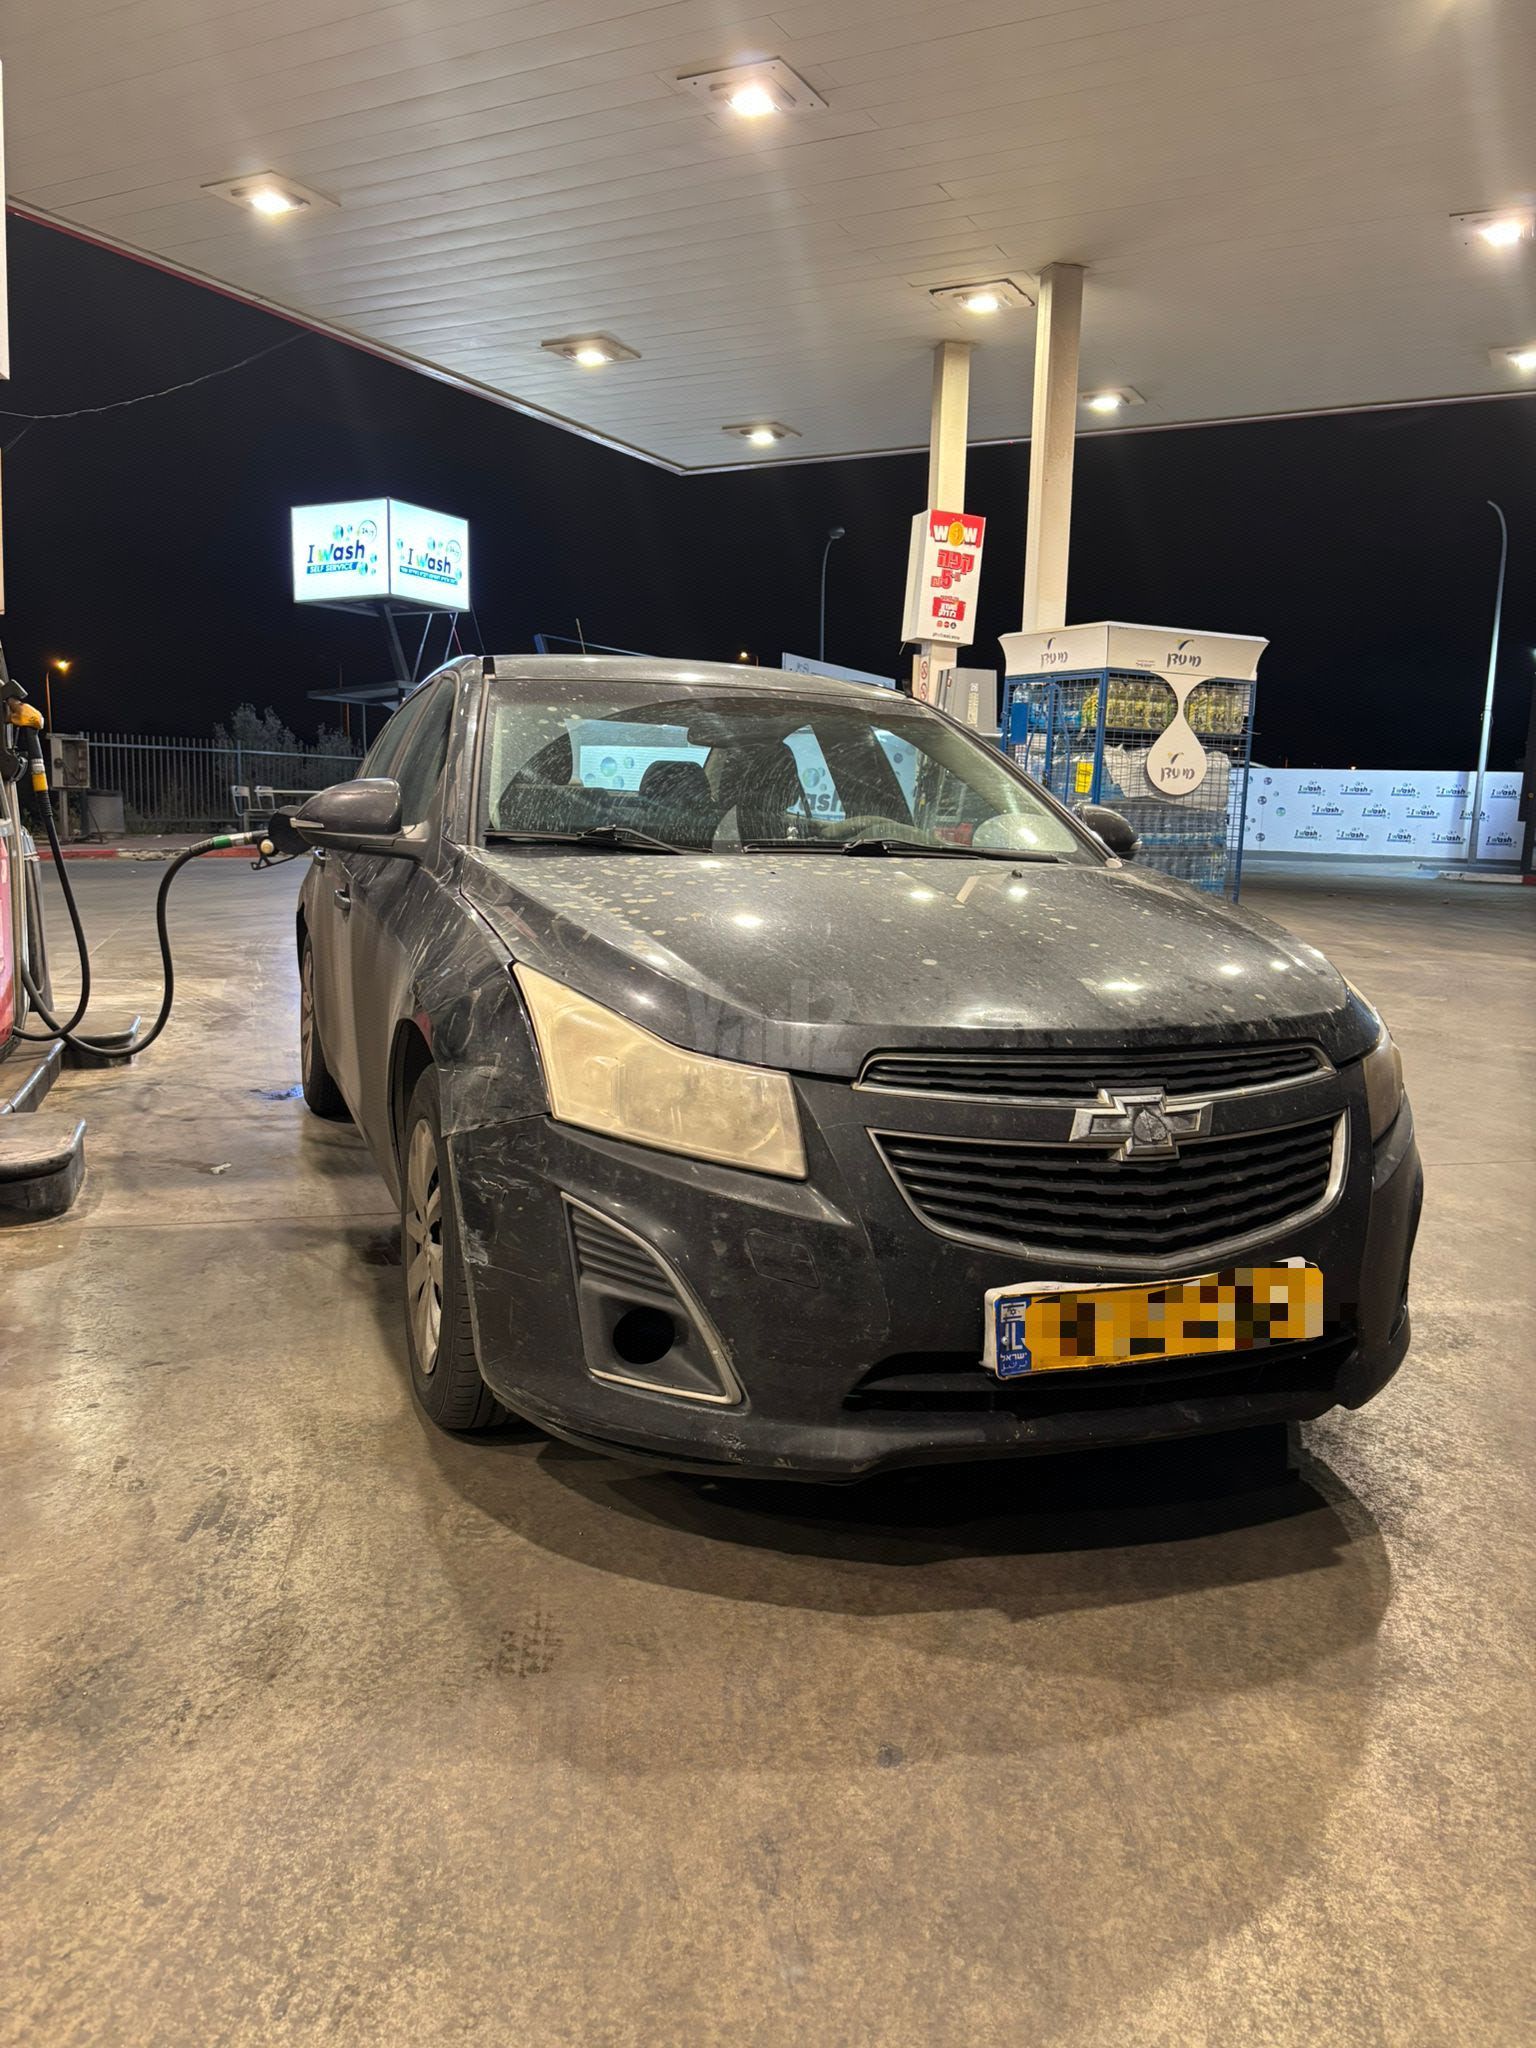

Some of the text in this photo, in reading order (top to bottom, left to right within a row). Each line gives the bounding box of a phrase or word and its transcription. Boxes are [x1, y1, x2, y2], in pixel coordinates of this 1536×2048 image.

[933, 521, 978, 545] WOW
[307, 544, 315, 563] I
[407, 547, 414, 565] I
[937, 549, 975, 575] קפה
[310, 562, 353, 573] SELF SERVICE
[1167, 652, 1187, 668] עדן
[1190, 655, 1202, 667] מי
[1160, 767, 1195, 782] מי עדן
[1003, 1321, 1024, 1351] IL
[1000, 1352, 1028, 1361] ישראל
